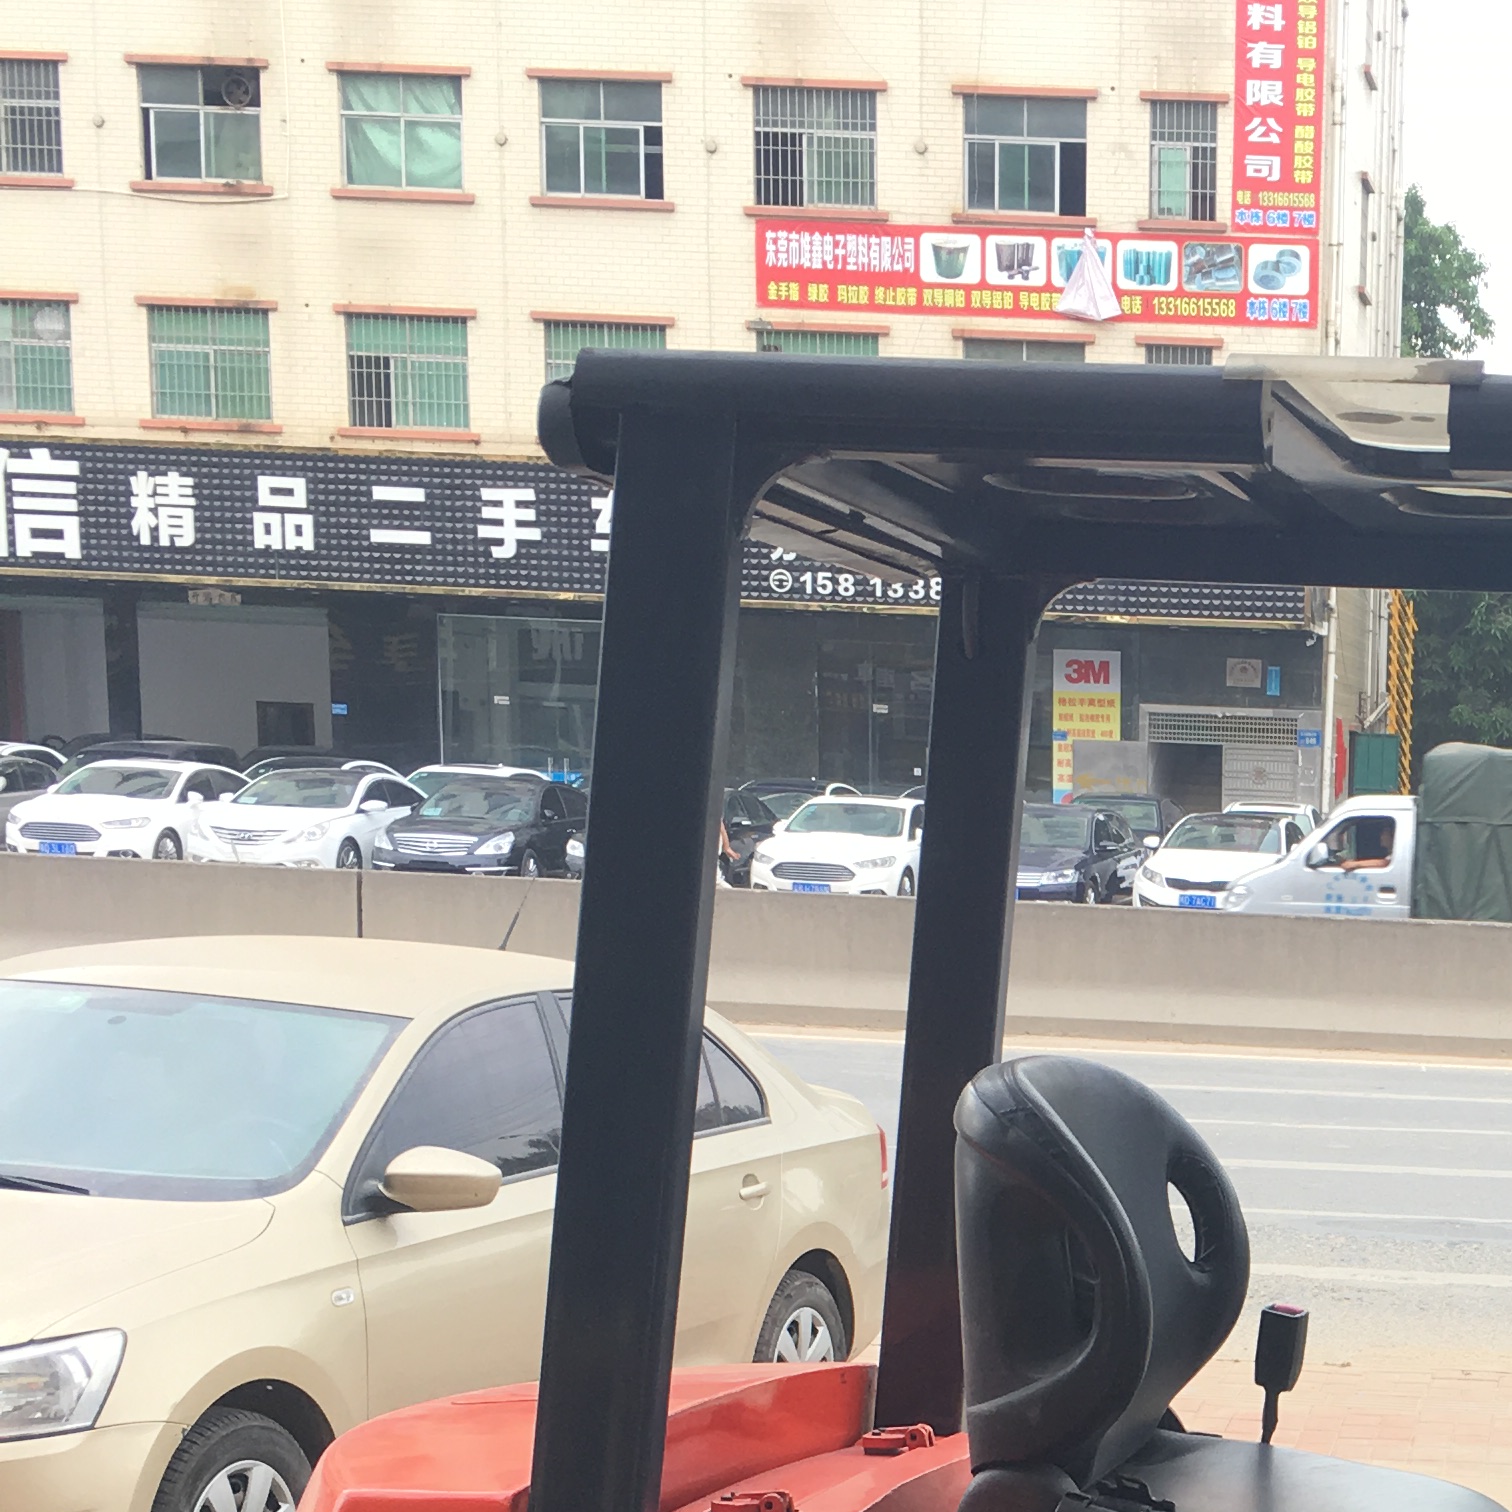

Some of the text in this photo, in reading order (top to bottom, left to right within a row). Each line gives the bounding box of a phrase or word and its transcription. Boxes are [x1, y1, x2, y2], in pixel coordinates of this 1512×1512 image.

[1296, 0, 1318, 49] 导铝铂
[1295, 57, 1317, 117] 导电胶带
[1258, 191, 1315, 207] 13316615568
[767, 281, 800, 302] 金手指
[1152, 296, 1236, 317] 13316615568
[799, 571, 855, 597] 158
[1064, 659, 1111, 685] 3M
